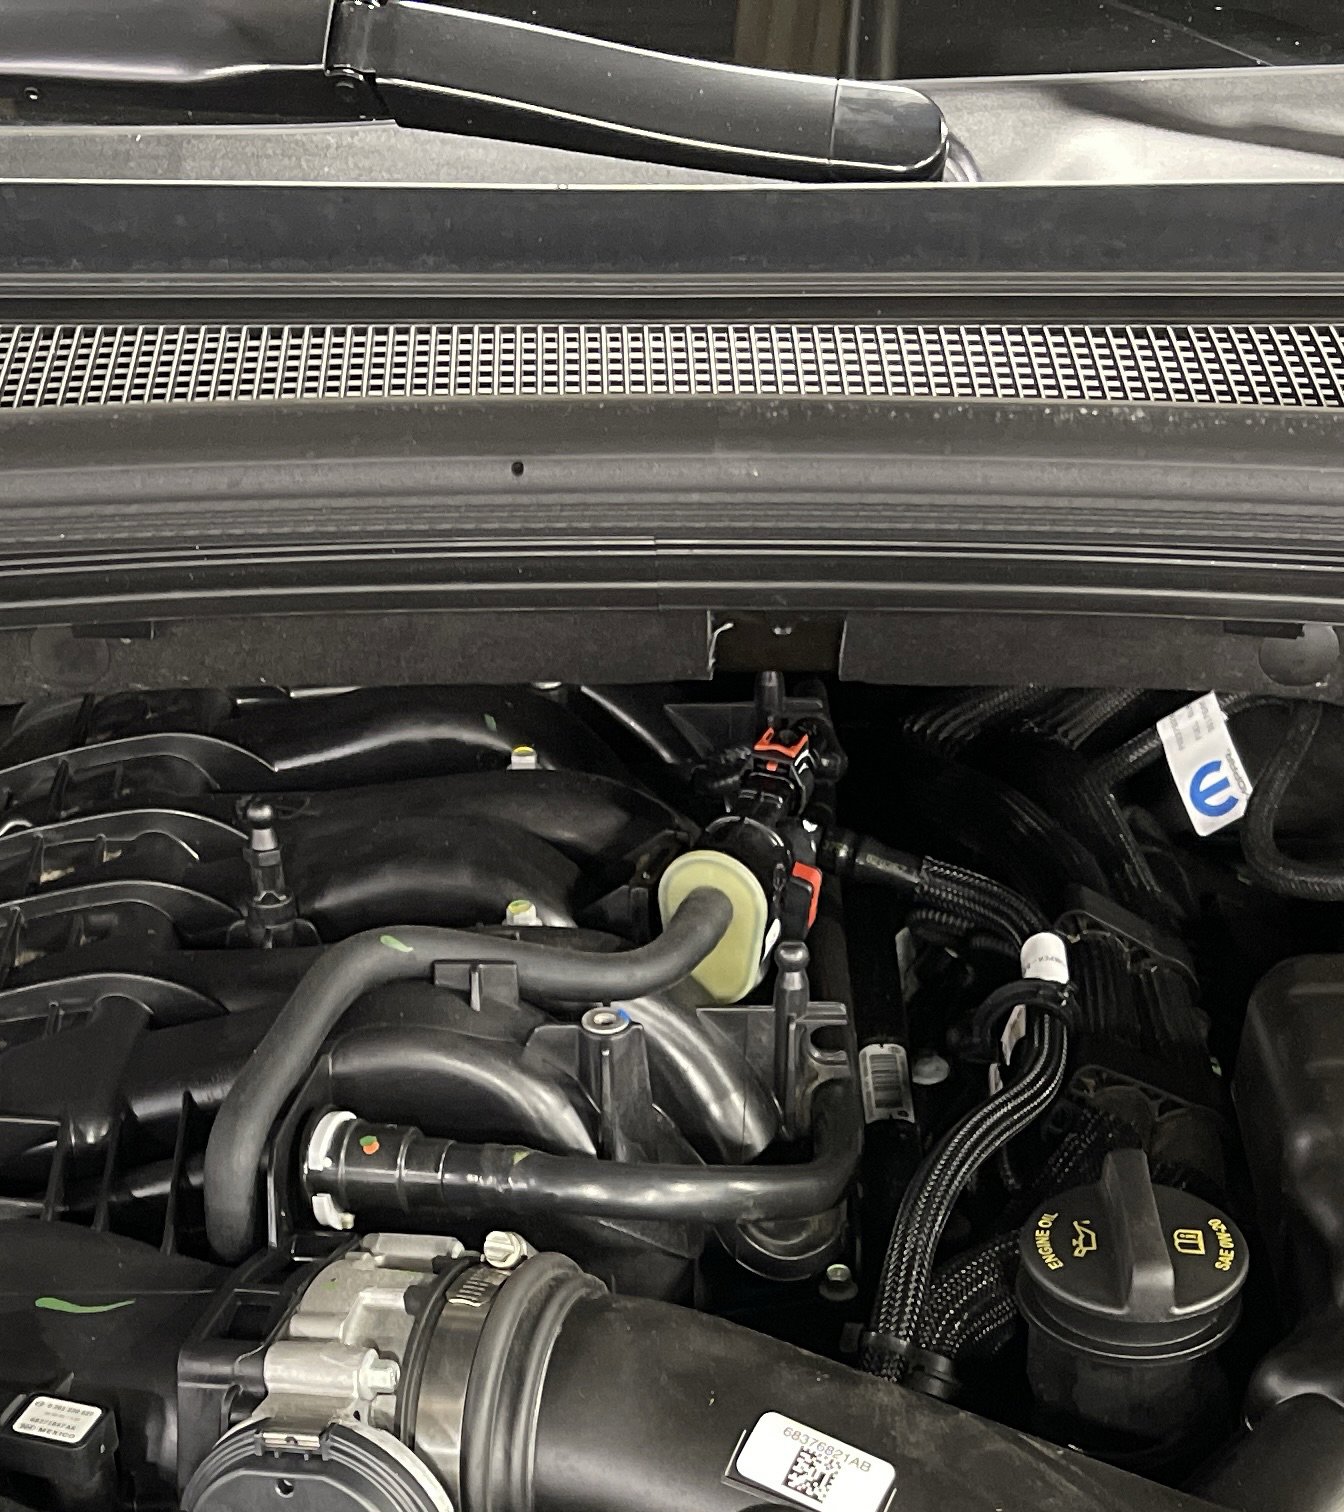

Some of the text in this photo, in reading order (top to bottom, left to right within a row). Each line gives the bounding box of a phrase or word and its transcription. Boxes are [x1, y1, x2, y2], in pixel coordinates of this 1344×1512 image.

[1035, 1213, 1064, 1270] ENGINE OIL
[1208, 1218, 1234, 1271] SAE 0W-20
[783, 1426, 872, 1473] 68376821AB
